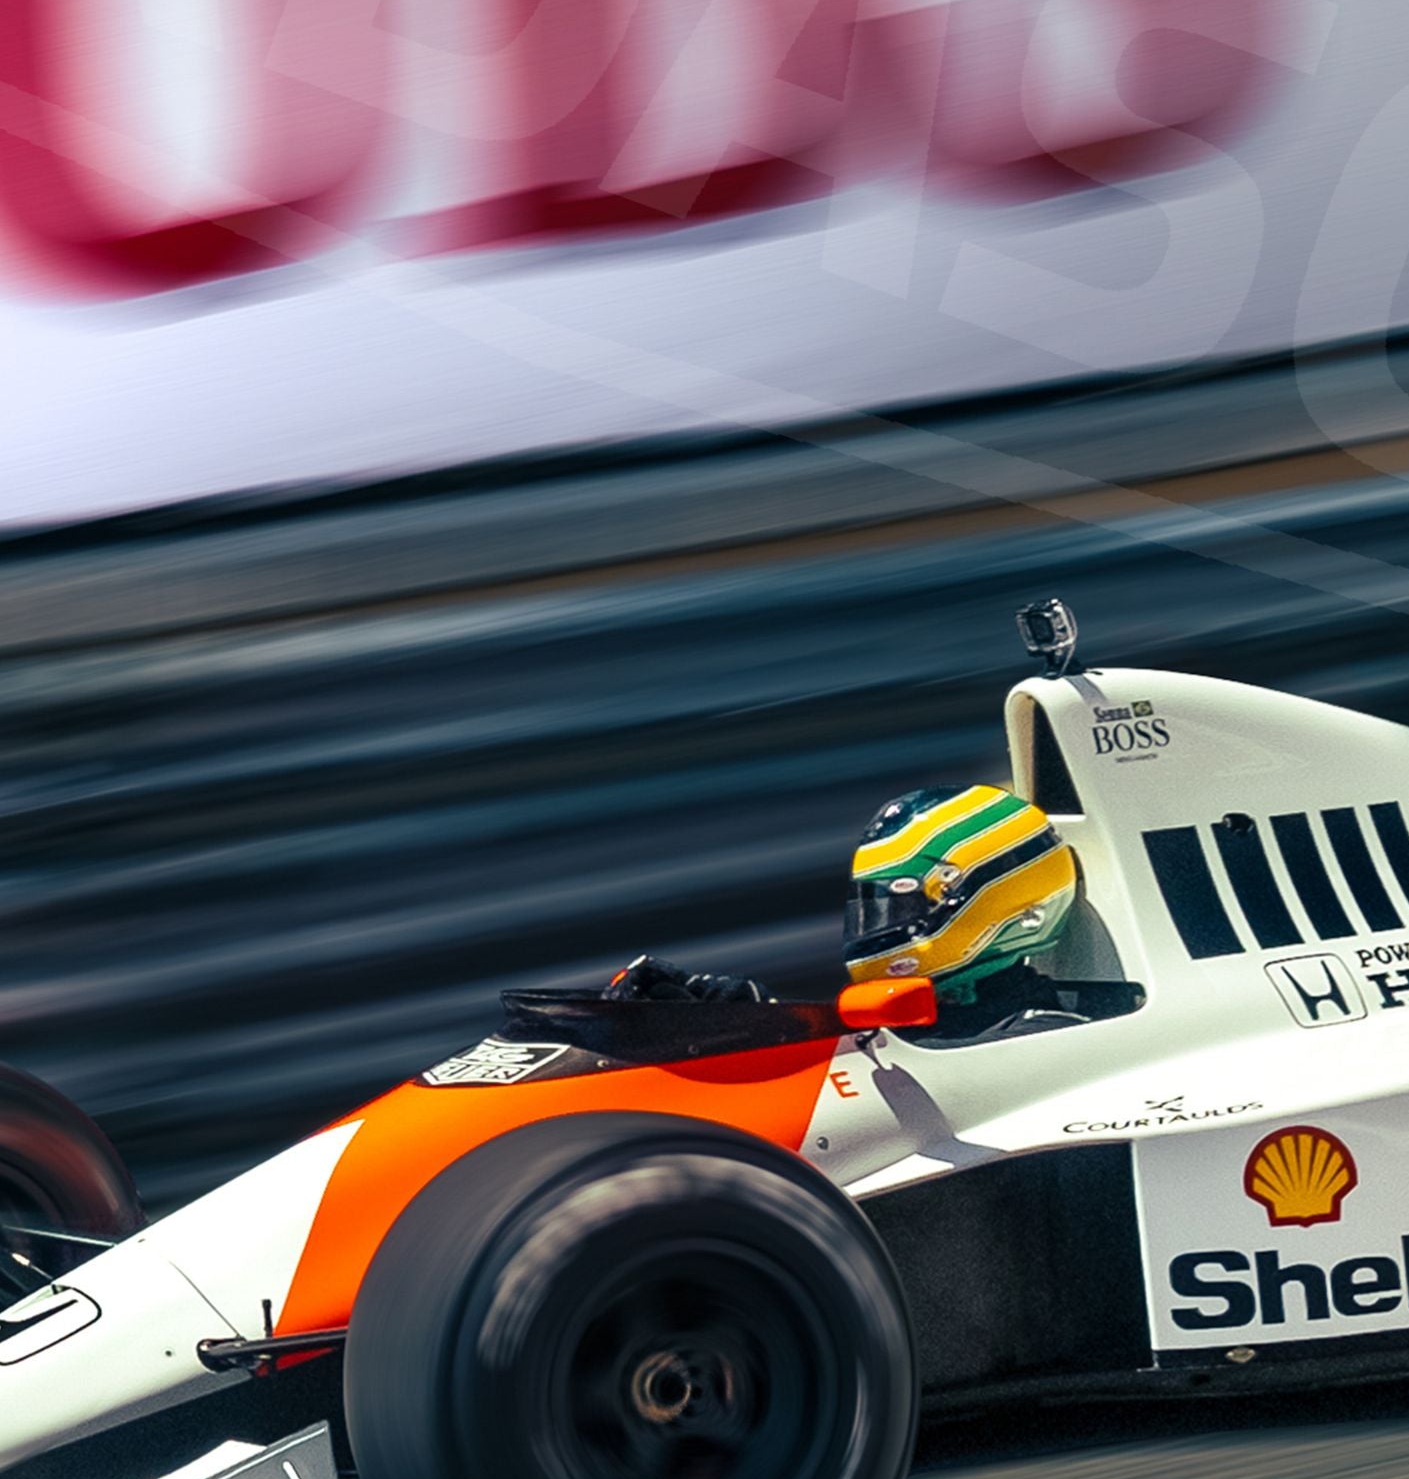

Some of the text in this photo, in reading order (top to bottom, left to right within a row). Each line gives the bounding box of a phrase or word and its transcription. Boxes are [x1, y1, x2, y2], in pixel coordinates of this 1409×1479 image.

[1092, 719, 1170, 755] BOSS
[829, 1071, 858, 1099] E
[1062, 1101, 1264, 1134] COURTAULDS
